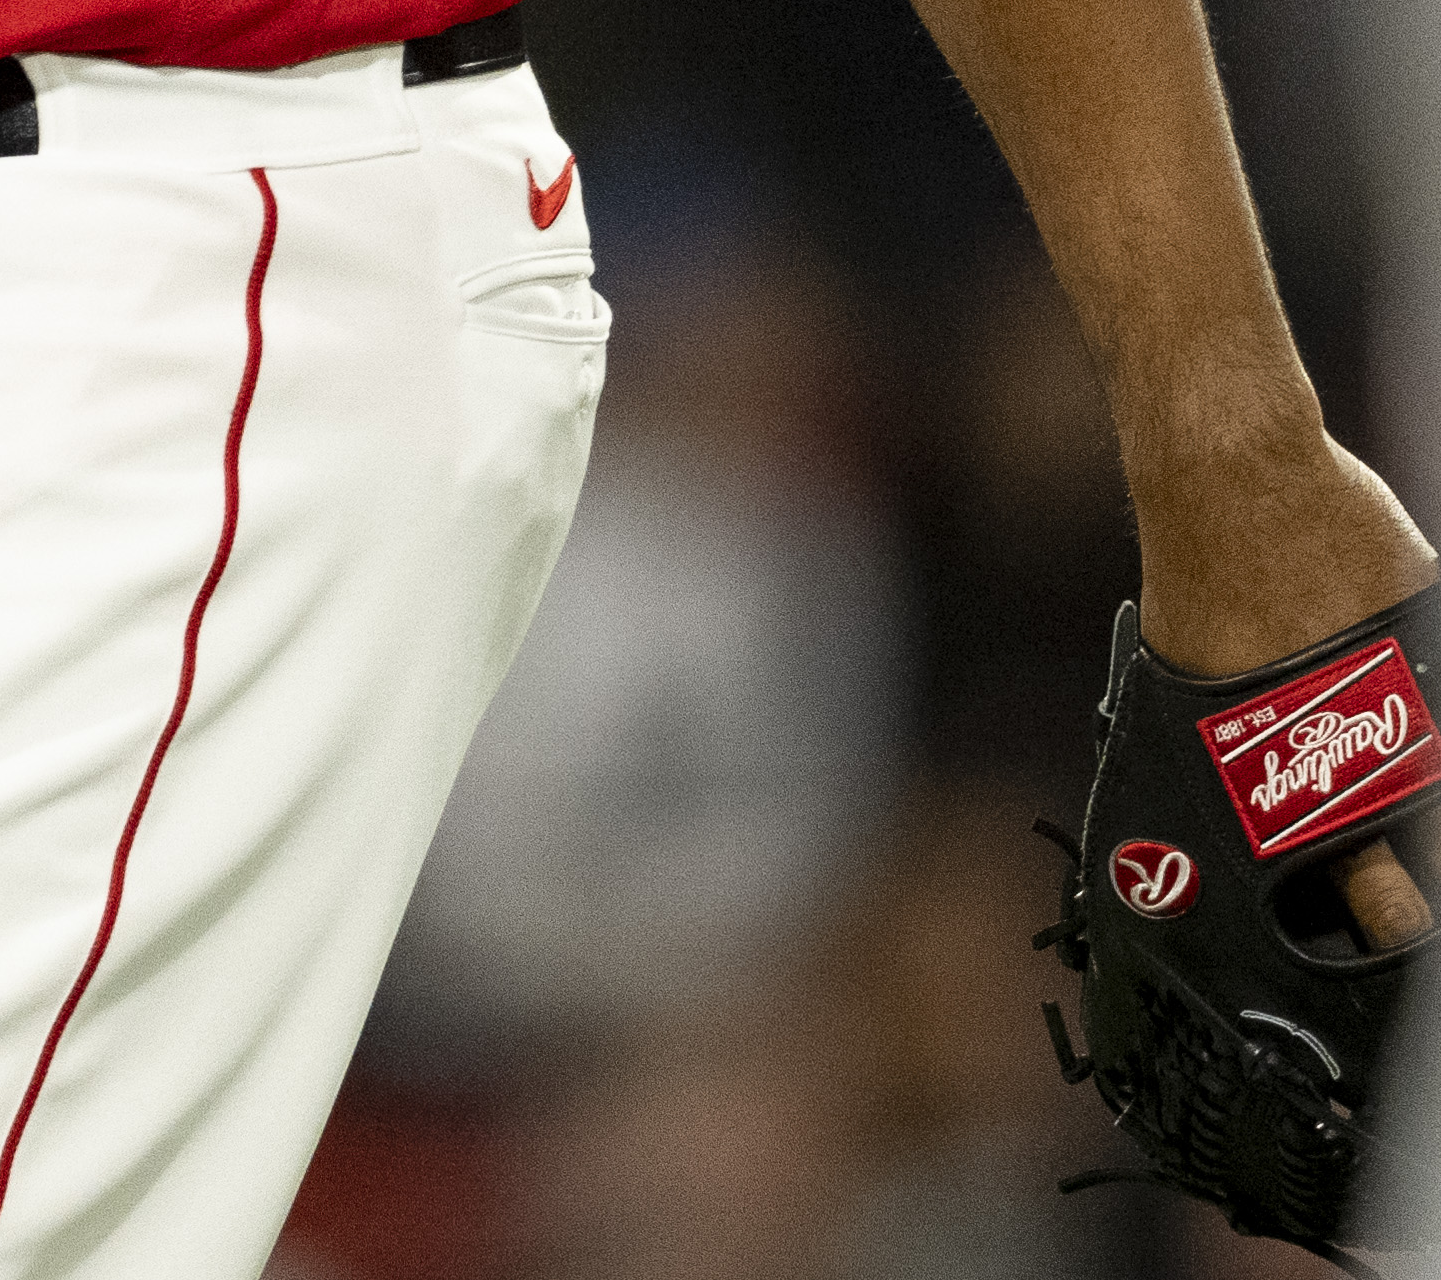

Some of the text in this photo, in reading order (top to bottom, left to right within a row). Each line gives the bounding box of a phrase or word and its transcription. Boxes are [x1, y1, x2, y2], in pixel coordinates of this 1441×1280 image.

[1214, 705, 1277, 743] Est. 1887
[1250, 693, 1409, 812] Rawlings
